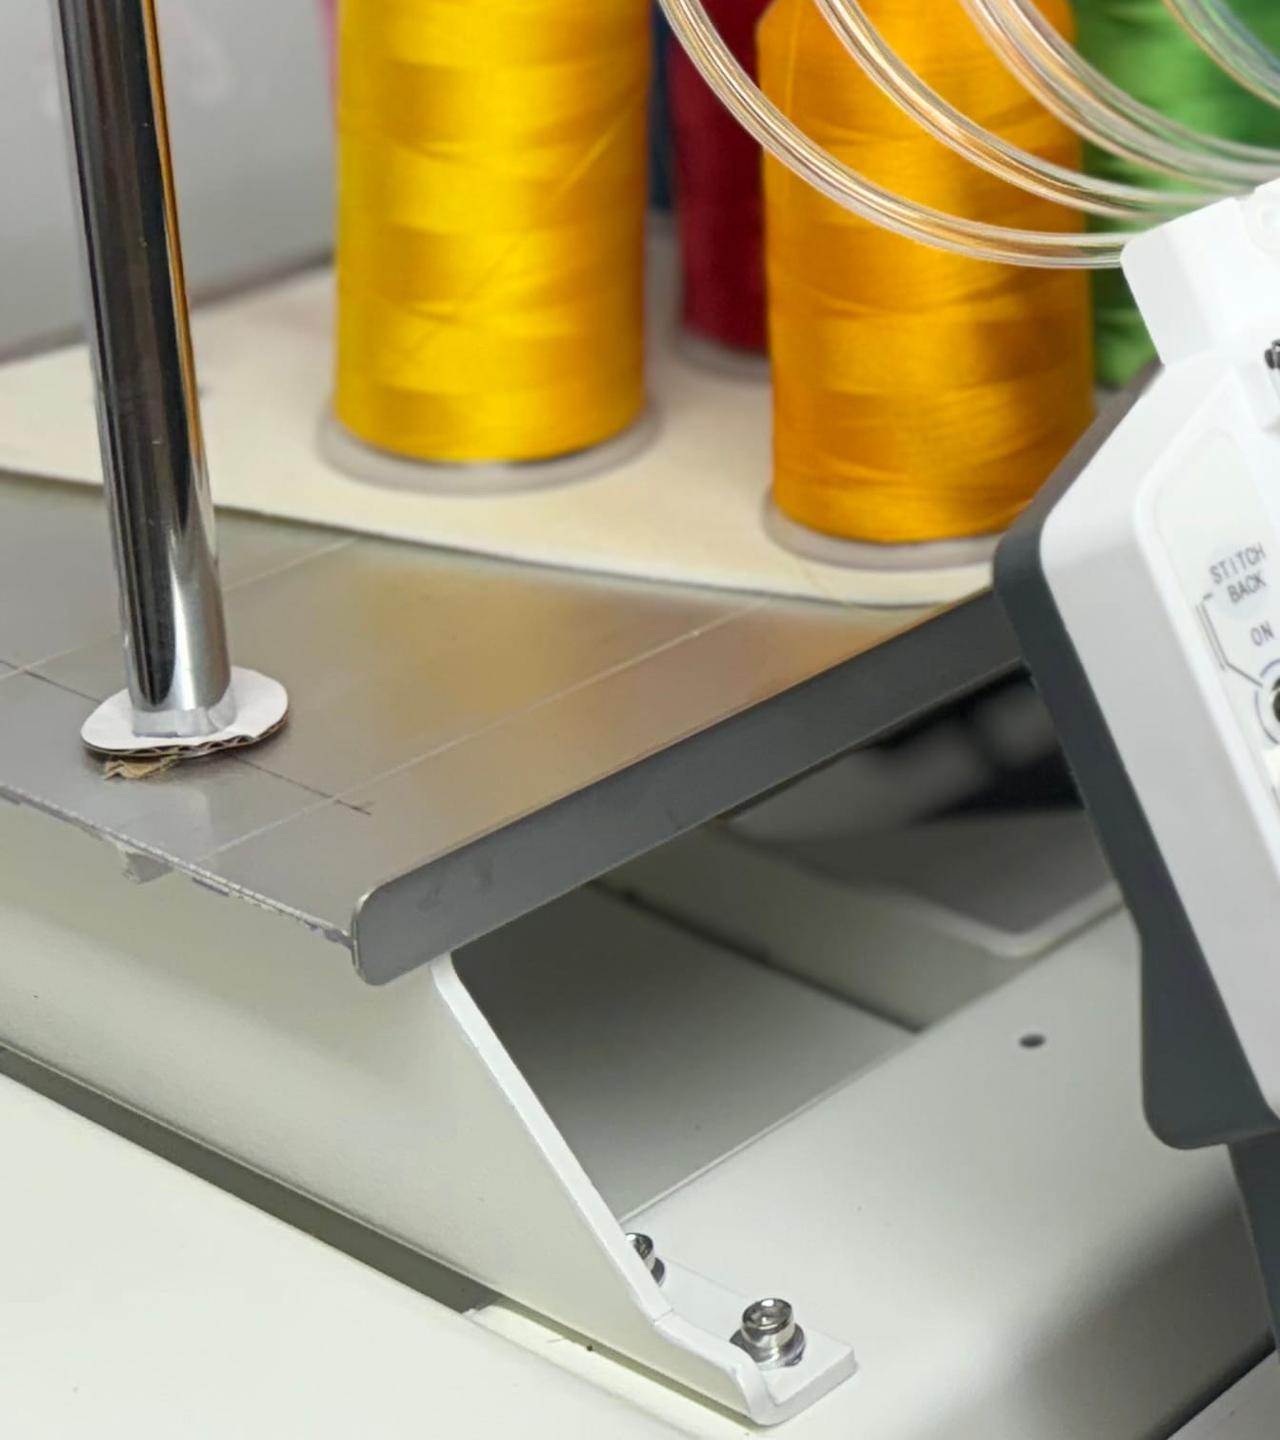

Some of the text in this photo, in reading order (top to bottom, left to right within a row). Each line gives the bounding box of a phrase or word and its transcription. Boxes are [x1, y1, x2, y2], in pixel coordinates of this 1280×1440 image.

[1210, 542, 1267, 584] STITCH
[1227, 570, 1267, 603] BACK
[1250, 620, 1275, 647] ON
